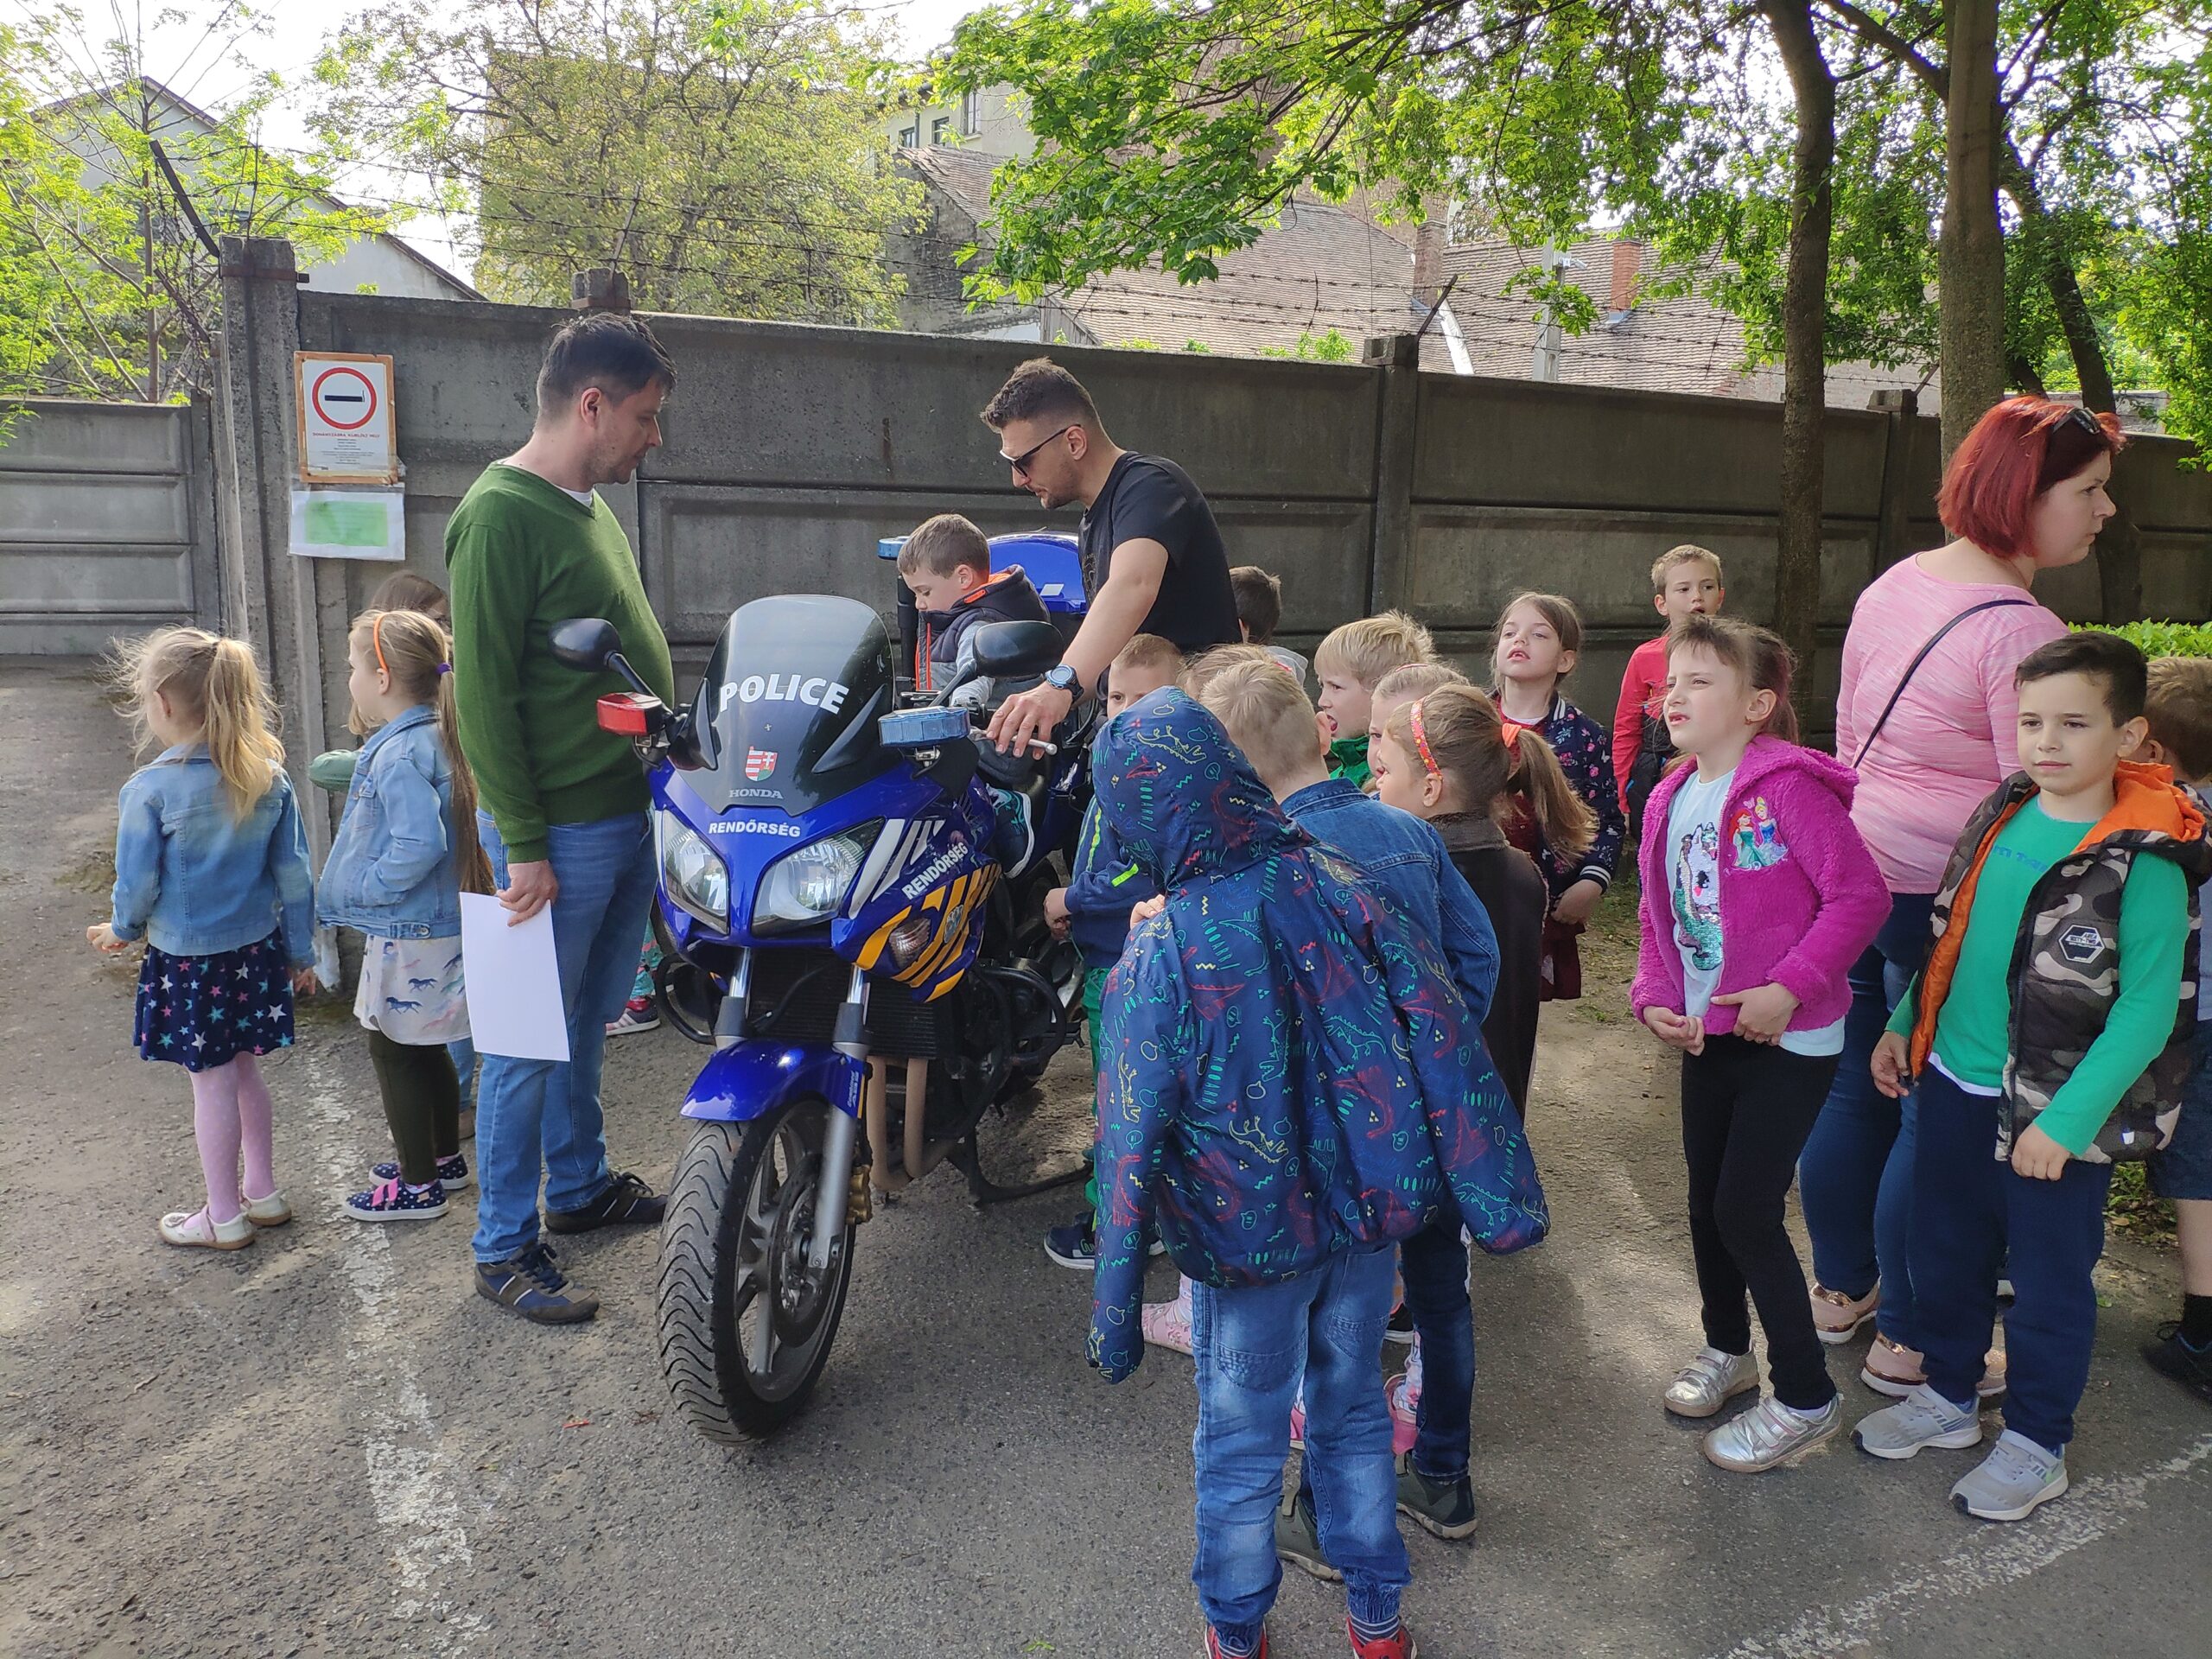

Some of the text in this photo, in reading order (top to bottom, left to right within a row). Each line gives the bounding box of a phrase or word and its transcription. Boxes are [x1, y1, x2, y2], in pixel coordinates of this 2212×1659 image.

[720, 673, 849, 715] POLICE
[728, 788, 784, 799] HONDA
[709, 819, 801, 837] RENDŐRSÉG
